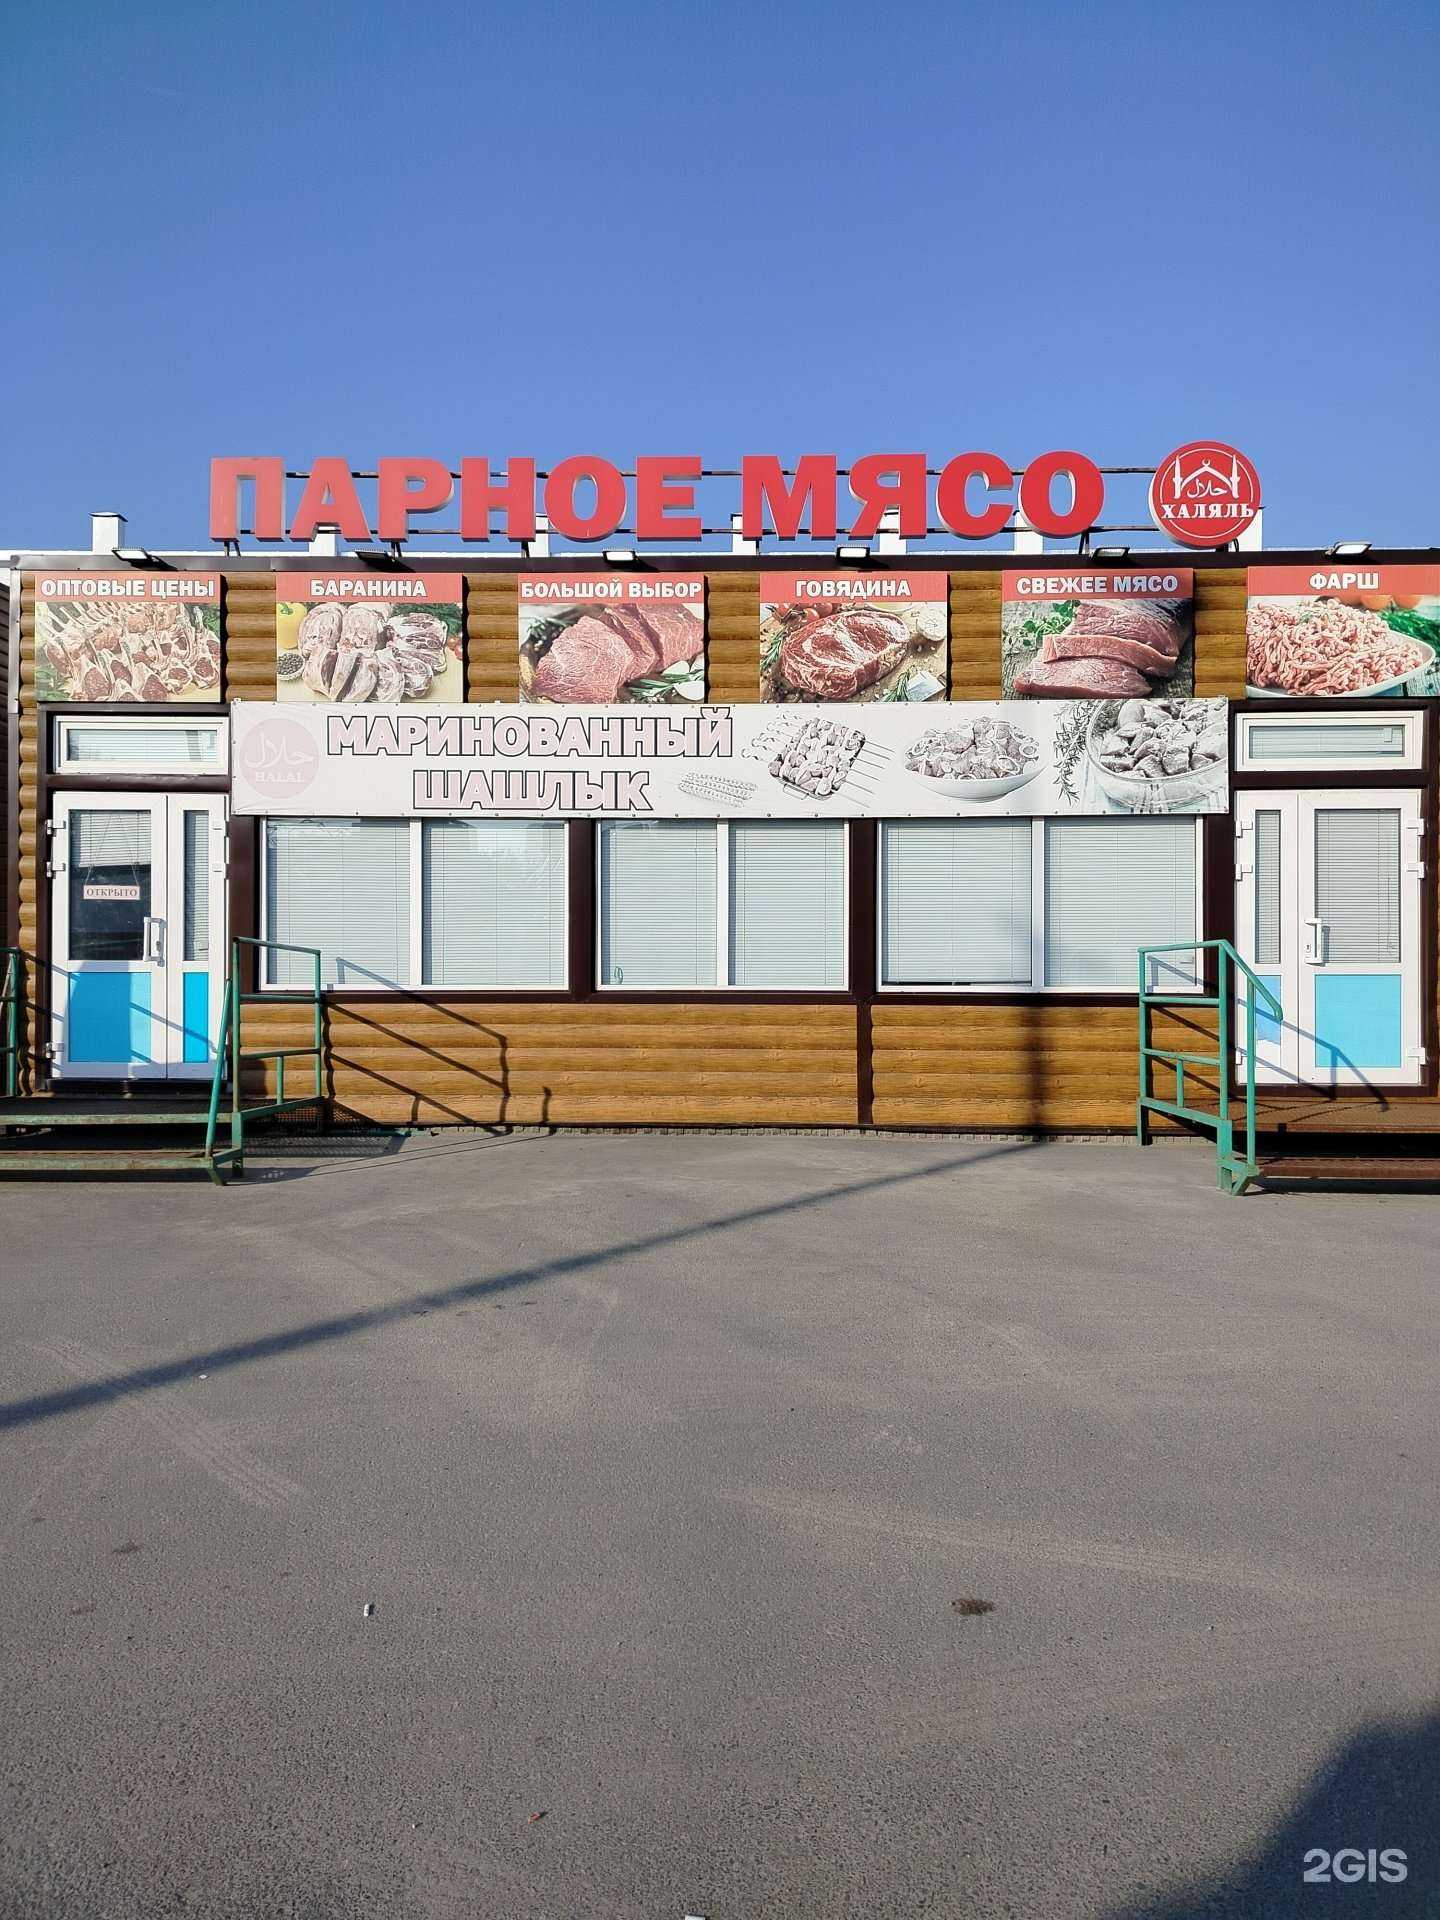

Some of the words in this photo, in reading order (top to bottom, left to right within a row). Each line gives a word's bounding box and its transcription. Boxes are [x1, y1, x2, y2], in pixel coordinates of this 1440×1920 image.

[210, 456, 702, 542] ПАРНОЕ
[742, 450, 1104, 541] МЯСО
[1186, 478, 1228, 498] حلال
[1161, 503, 1254, 519] ХАЛЯЛЬ
[40, 579, 145, 597] ОПТОВЫЕ
[151, 579, 215, 599] ЦЕНЫ
[310, 579, 427, 597] БАРАНИНА
[521, 577, 623, 598] БОЛЬШОЙ
[628, 582, 702, 599] ВЫБОР
[795, 579, 912, 599] ГОВЯДИНА
[1016, 576, 1107, 595] СВЕЖЕЕ
[1113, 575, 1178, 593] МЯСО
[1309, 571, 1380, 590] ФАРШ
[327, 707, 733, 757] МАРИНОВАННЫЙ
[413, 770, 653, 811] ШАШЛЫК
[86, 888, 138, 897] ОТКРЫТО
